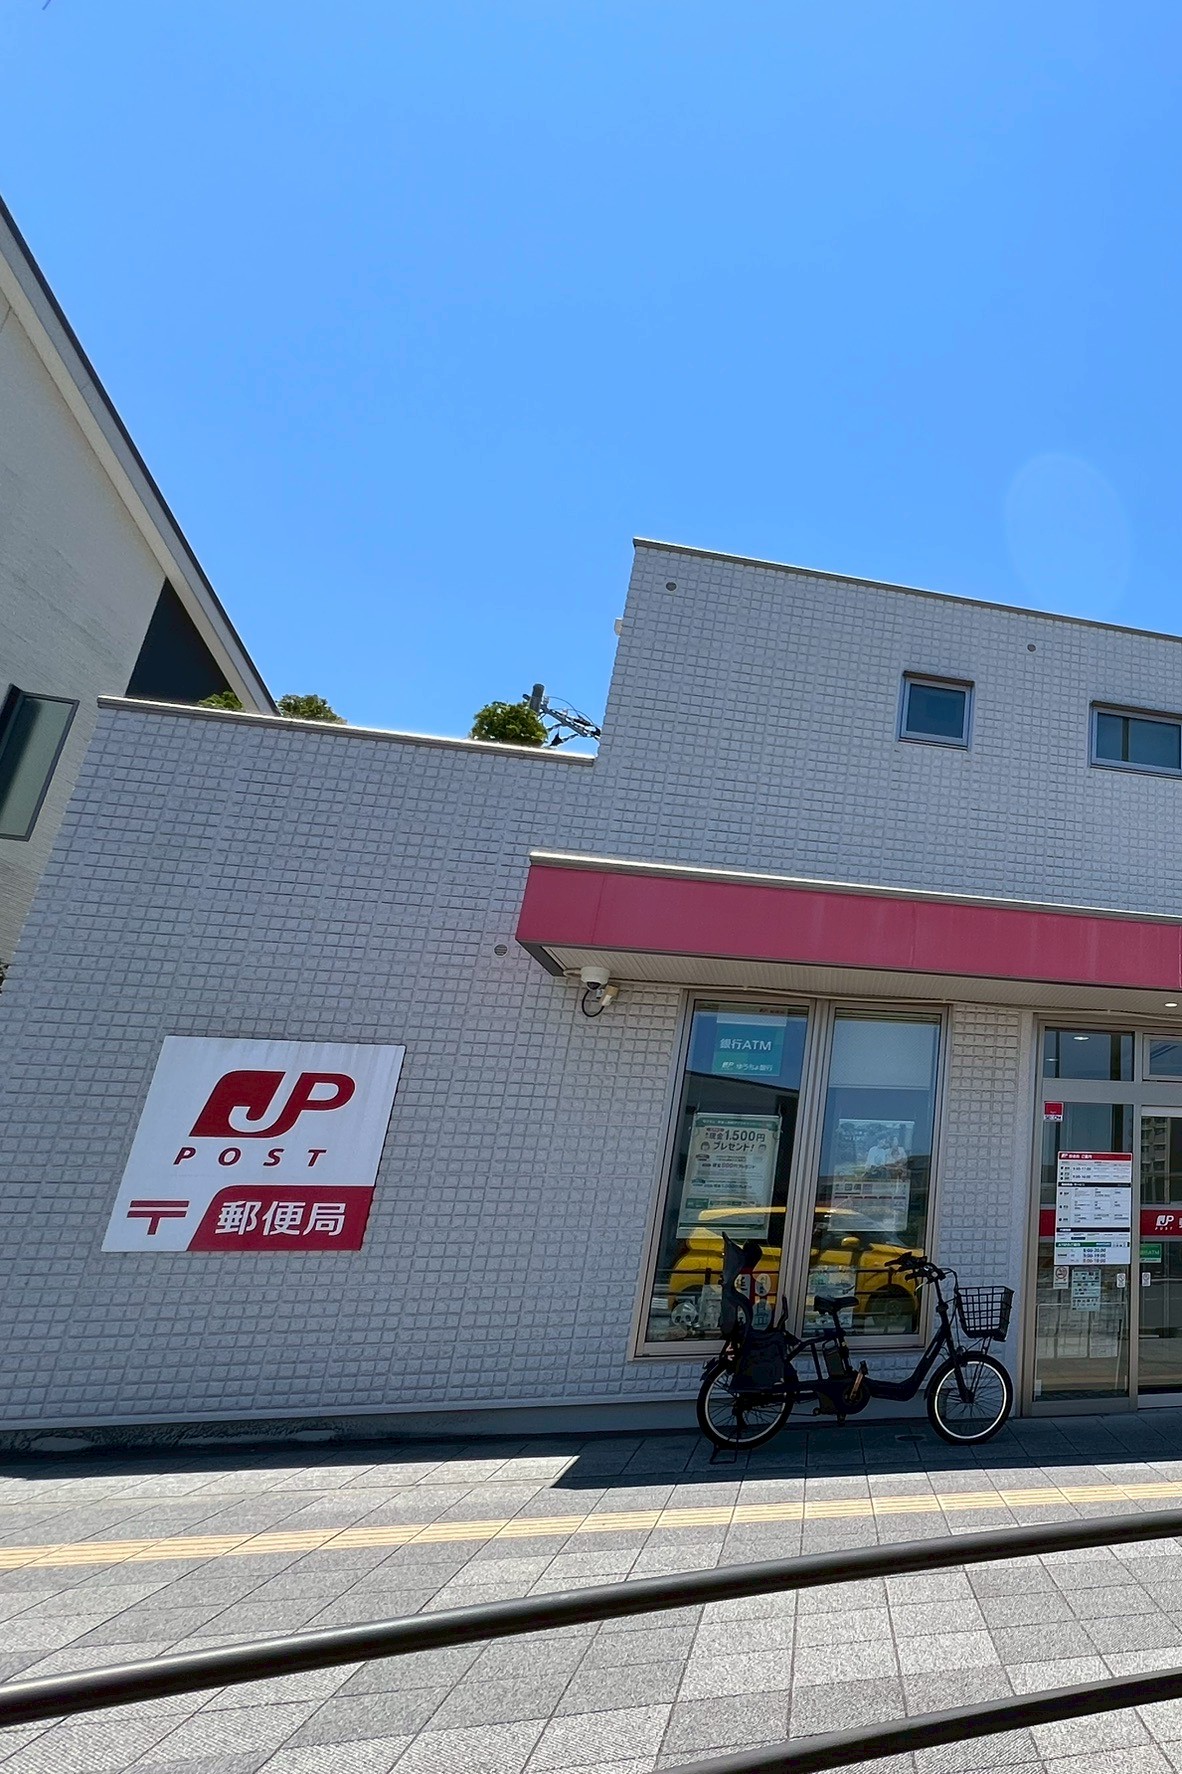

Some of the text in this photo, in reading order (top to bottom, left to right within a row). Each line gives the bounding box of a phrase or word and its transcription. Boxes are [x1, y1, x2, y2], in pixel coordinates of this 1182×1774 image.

[720, 1038, 772, 1051] 銀行ATM
[188, 1070, 356, 1139] JP
[173, 1147, 327, 1167] POST
[215, 1201, 347, 1236] 郵便局
